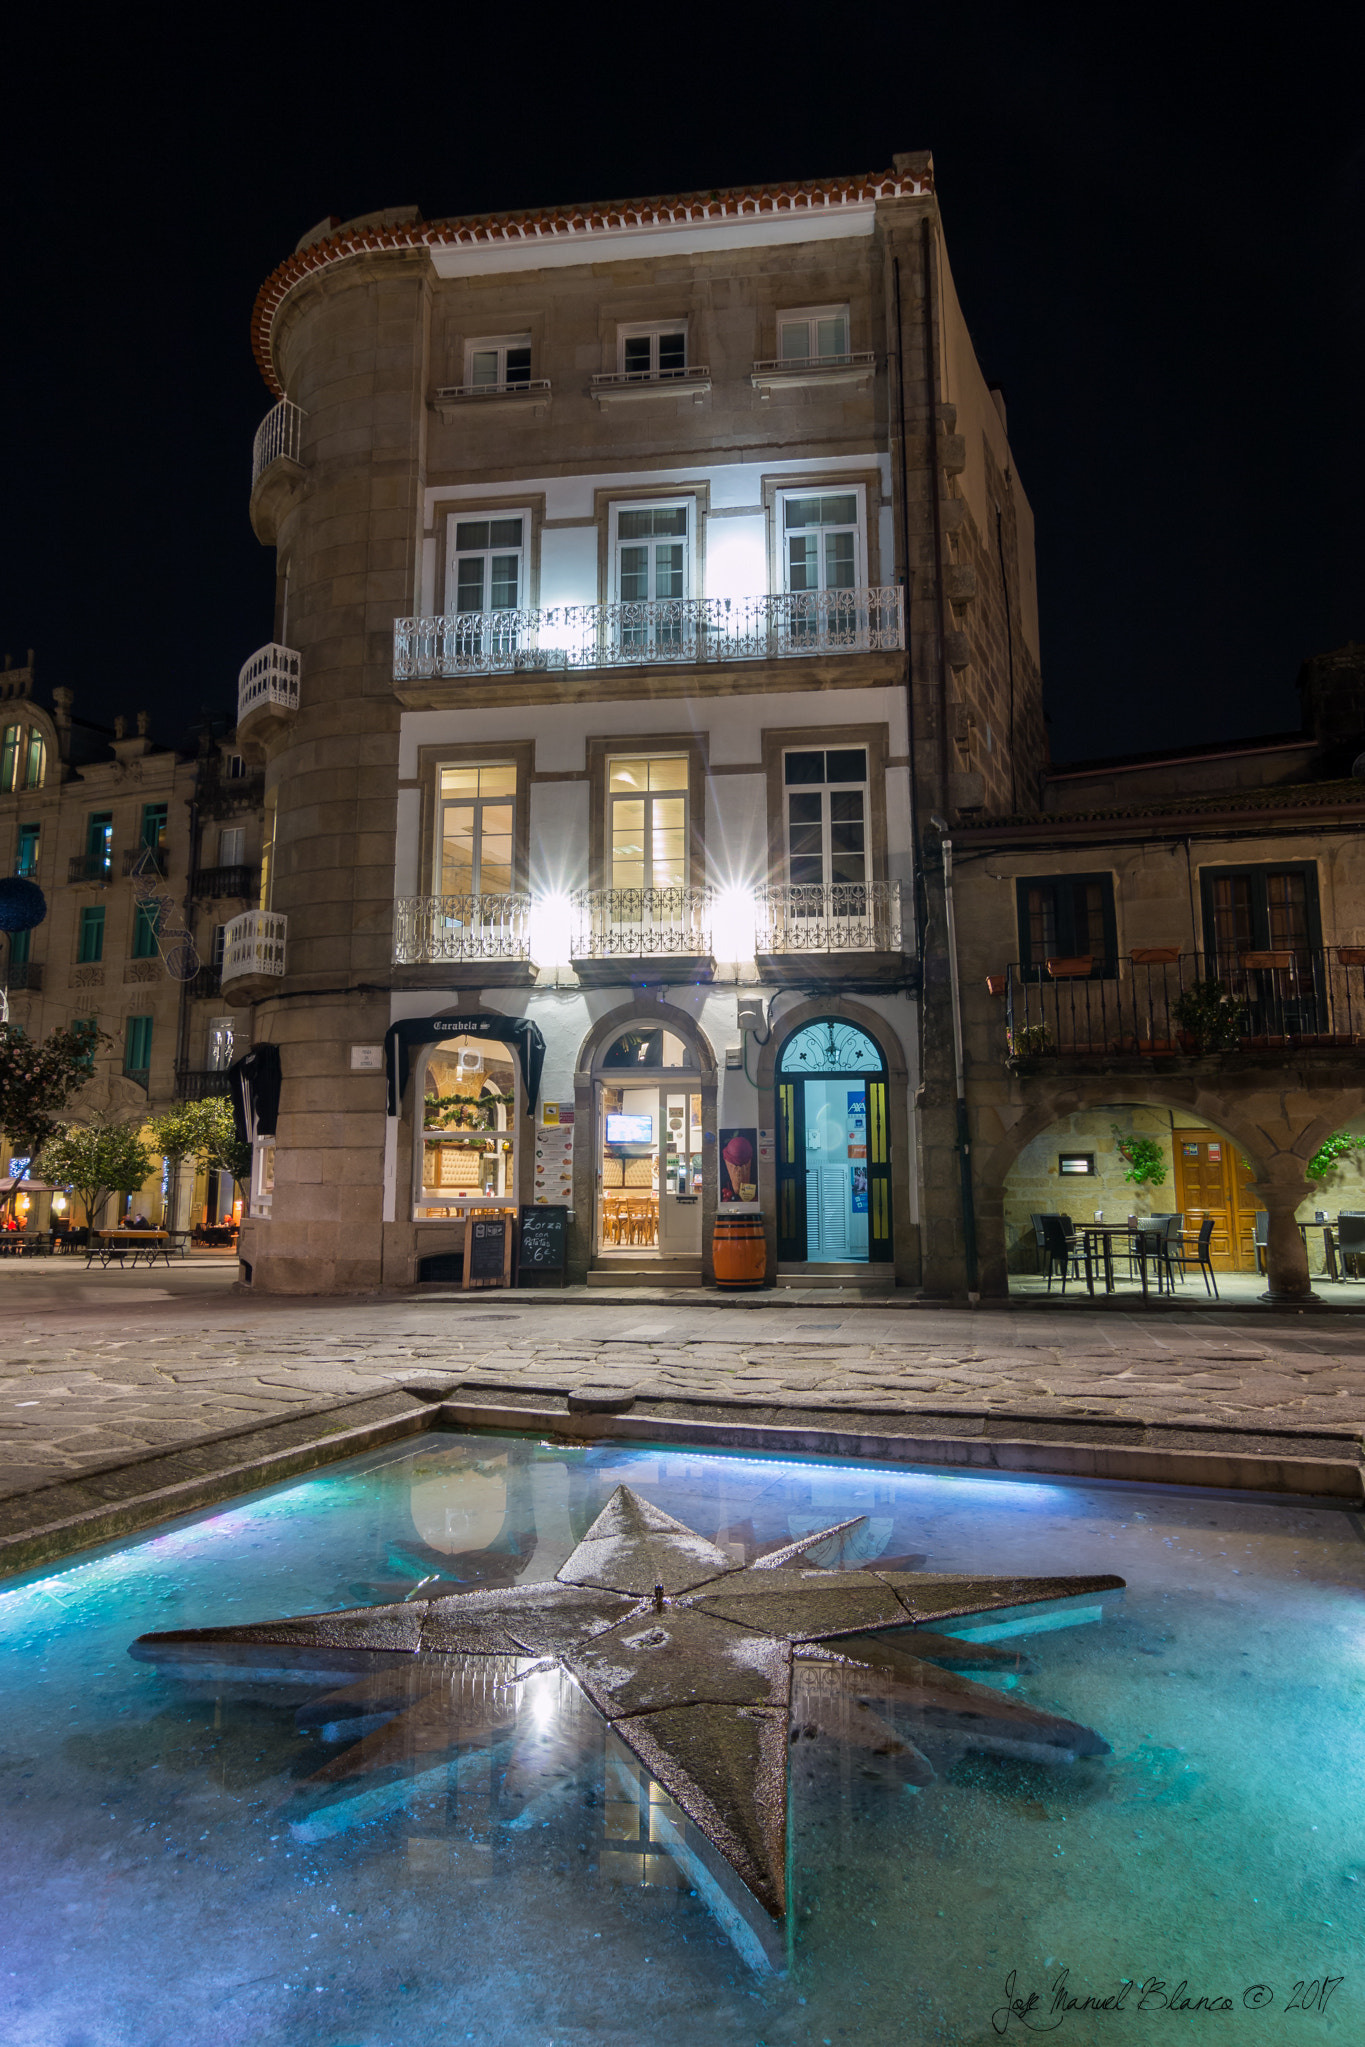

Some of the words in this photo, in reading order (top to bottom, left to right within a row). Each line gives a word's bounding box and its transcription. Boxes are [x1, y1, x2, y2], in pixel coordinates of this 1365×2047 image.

[433, 1021, 477, 1030] Carabela
[848, 1102, 866, 1113] AXA
[523, 1217, 562, 1230] Zorza
